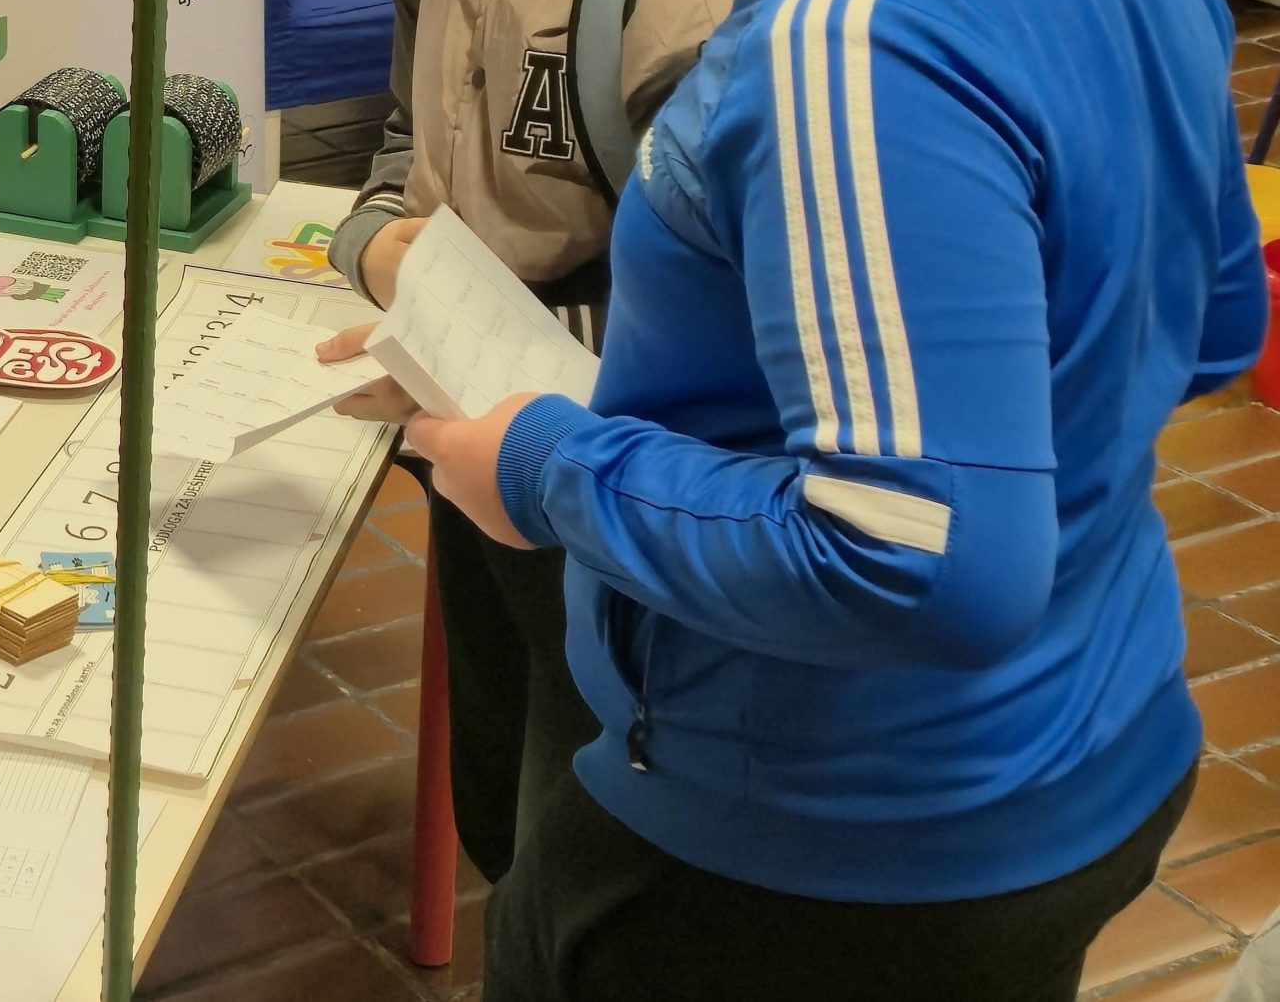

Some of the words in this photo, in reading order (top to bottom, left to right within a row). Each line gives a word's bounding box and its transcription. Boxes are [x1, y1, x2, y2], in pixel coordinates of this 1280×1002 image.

[500, 49, 575, 160] A
[149, 512, 186, 553] PODLOGA
[176, 497, 192, 510] ZA
